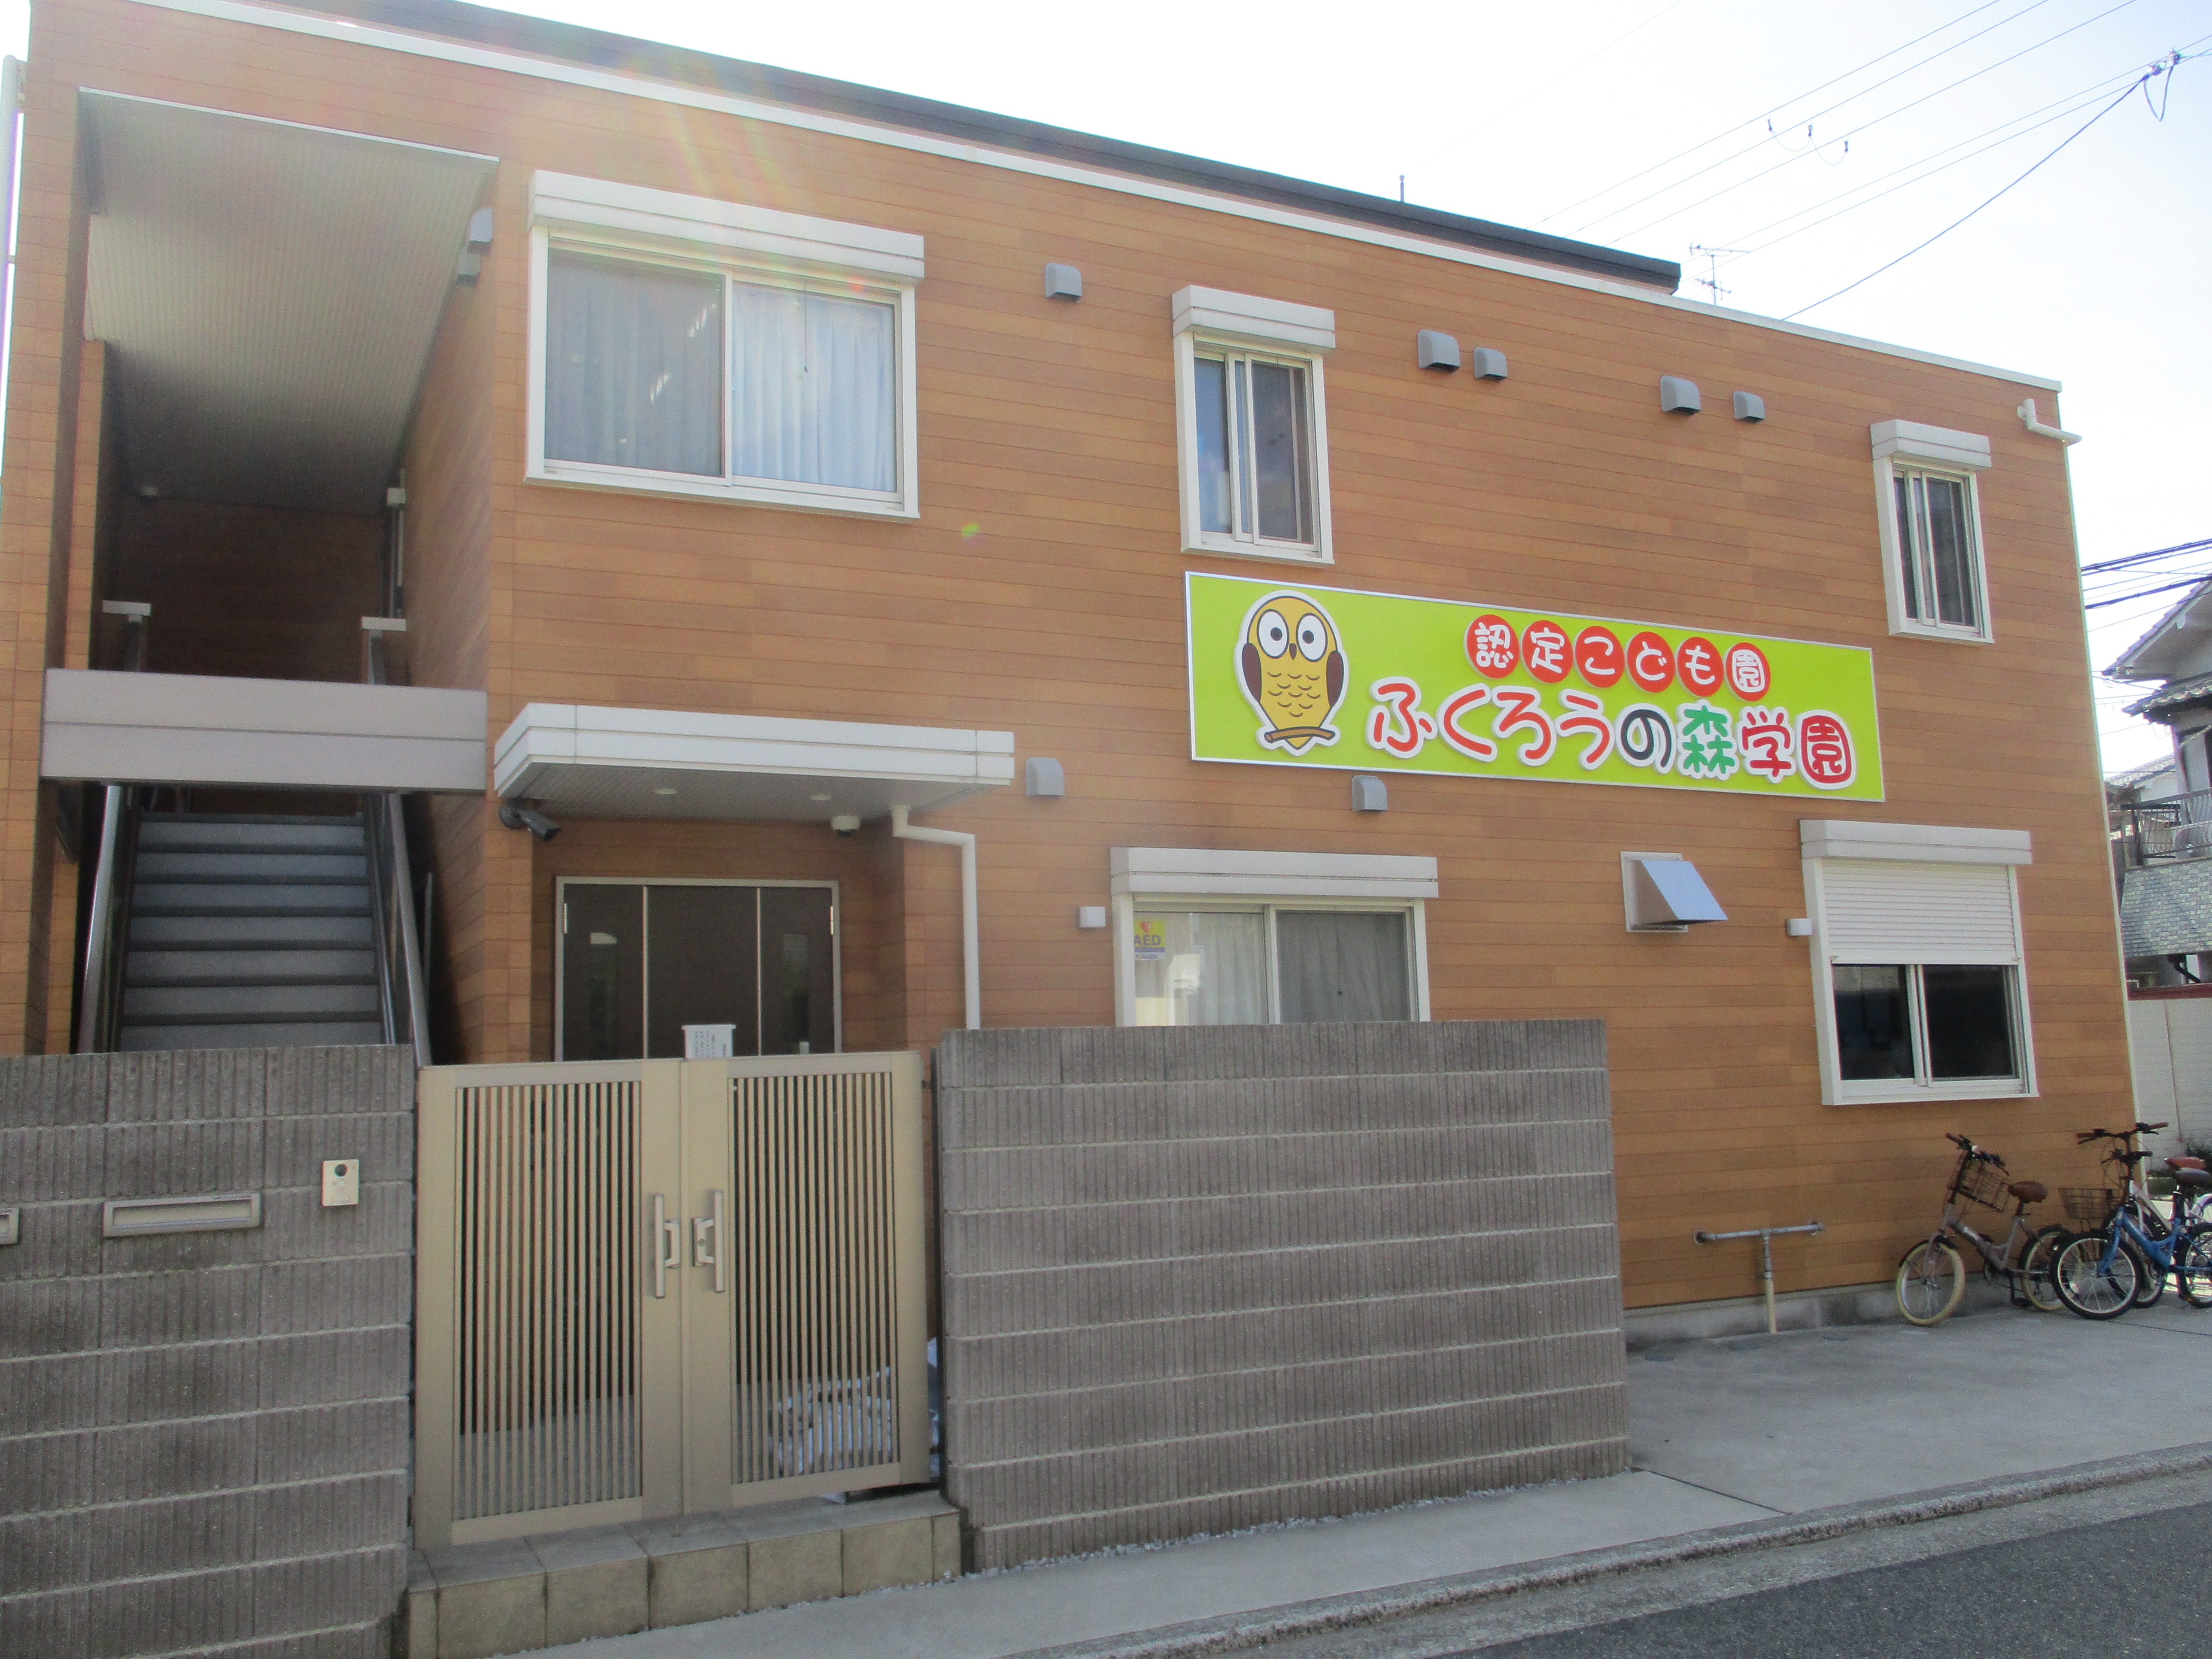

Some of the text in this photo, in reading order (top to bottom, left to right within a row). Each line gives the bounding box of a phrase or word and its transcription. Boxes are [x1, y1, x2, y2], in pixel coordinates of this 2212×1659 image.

[1474, 621, 1766, 693] 認定こども園
[1370, 681, 1854, 786] ふくろうの森学園
[1134, 935, 1161, 945] AED
